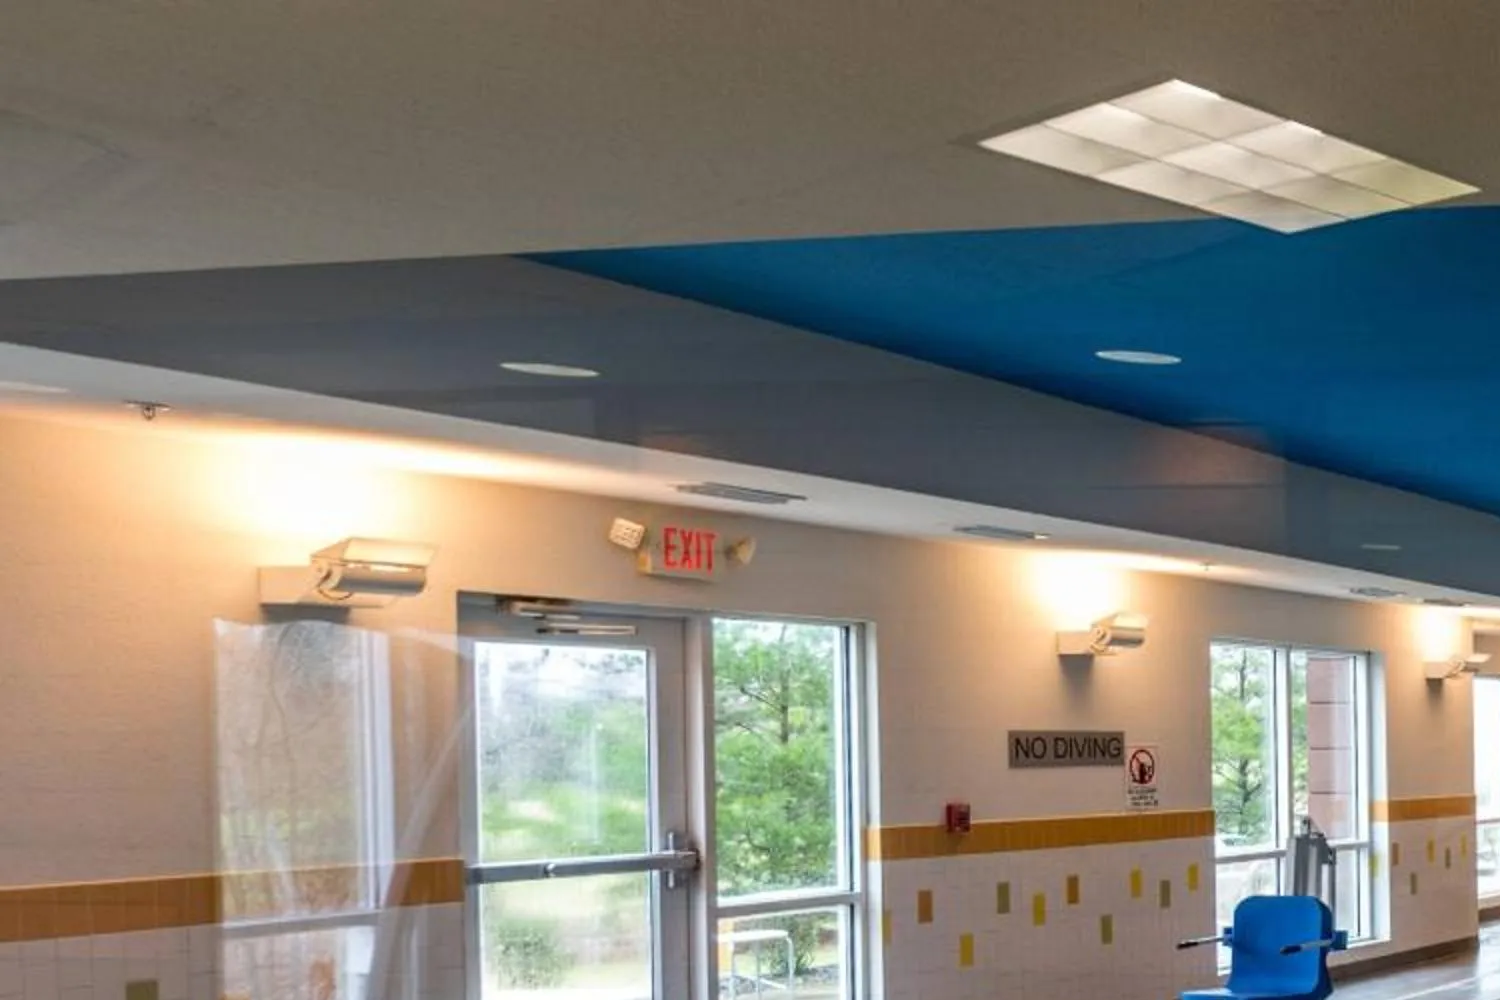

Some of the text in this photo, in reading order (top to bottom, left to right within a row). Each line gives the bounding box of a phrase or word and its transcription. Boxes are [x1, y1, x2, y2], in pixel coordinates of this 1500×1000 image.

[663, 528, 716, 574] EXIT
[1014, 736, 1121, 760] NO DIVING
